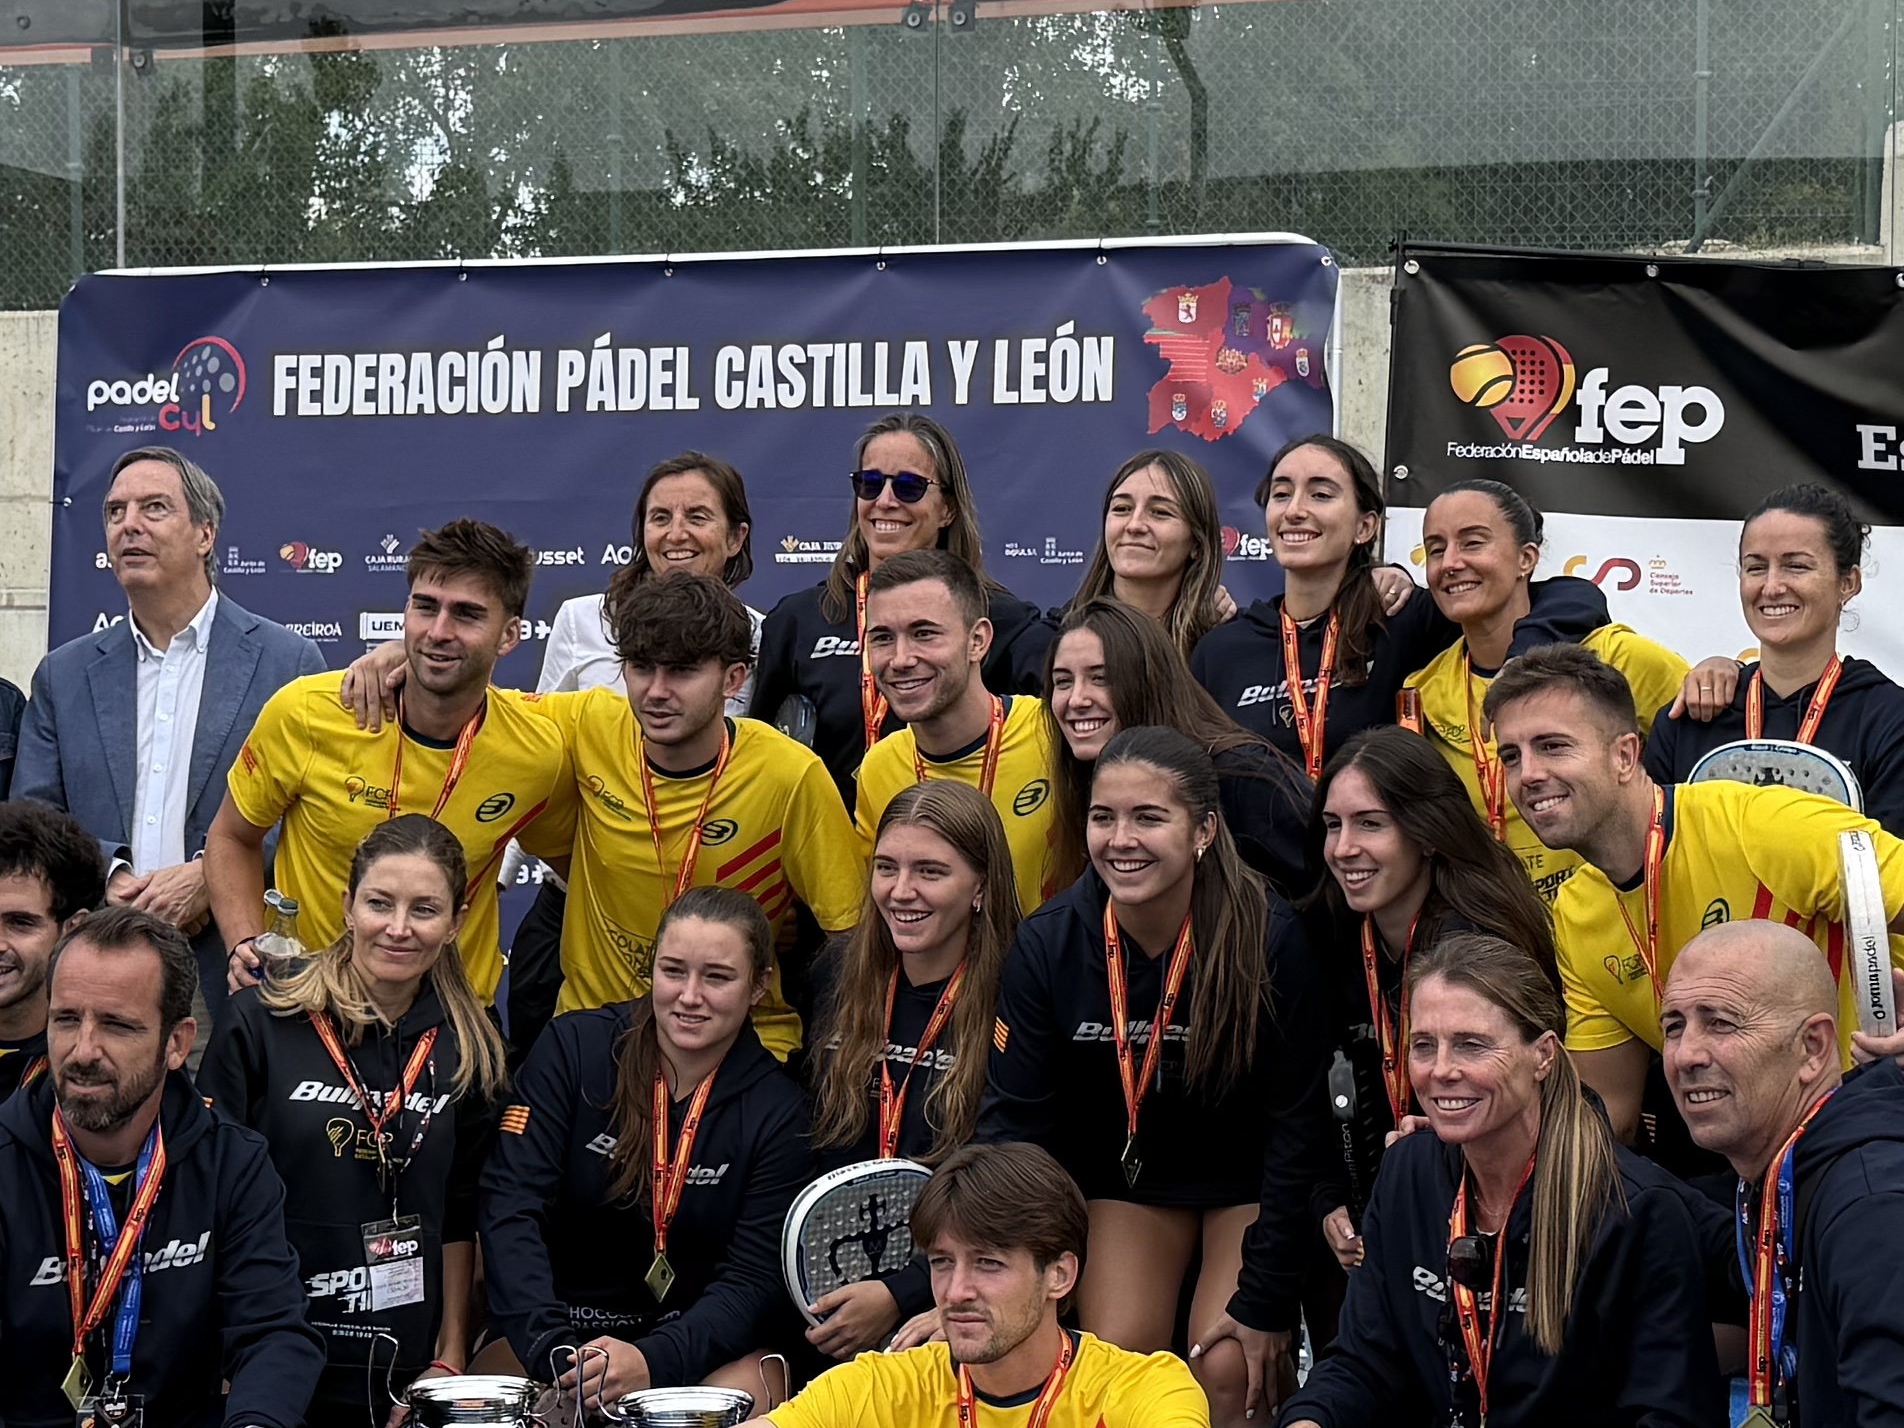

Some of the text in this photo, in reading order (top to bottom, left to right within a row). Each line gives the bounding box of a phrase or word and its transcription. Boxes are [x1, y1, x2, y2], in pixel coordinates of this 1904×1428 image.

[273, 320, 1114, 417] FEDERACIÓN PÁDEL CASTILLA Y LEÓN
[87, 372, 180, 411] padel
[1575, 367, 1725, 465] fep
[308, 548, 342, 573] fep
[387, 554, 412, 564] RURA
[305, 1266, 371, 1297] SPO
